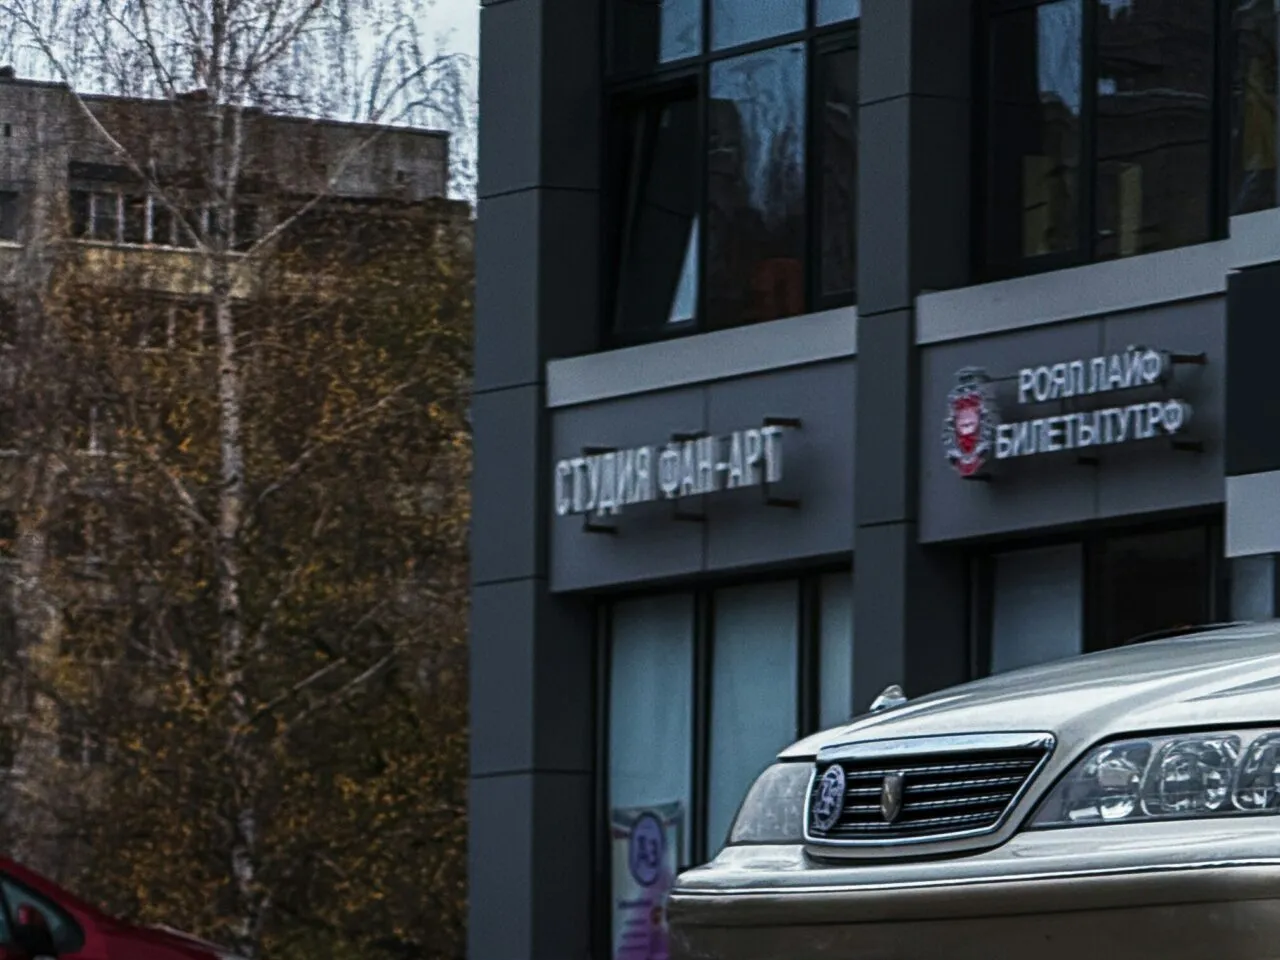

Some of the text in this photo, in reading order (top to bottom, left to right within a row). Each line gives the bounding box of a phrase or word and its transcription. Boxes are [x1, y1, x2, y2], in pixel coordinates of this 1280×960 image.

[1018, 344, 1163, 403] РОЯЛ ЛАЙФ
[555, 425, 783, 516] СТУДИЯ ФАН-АРТ
